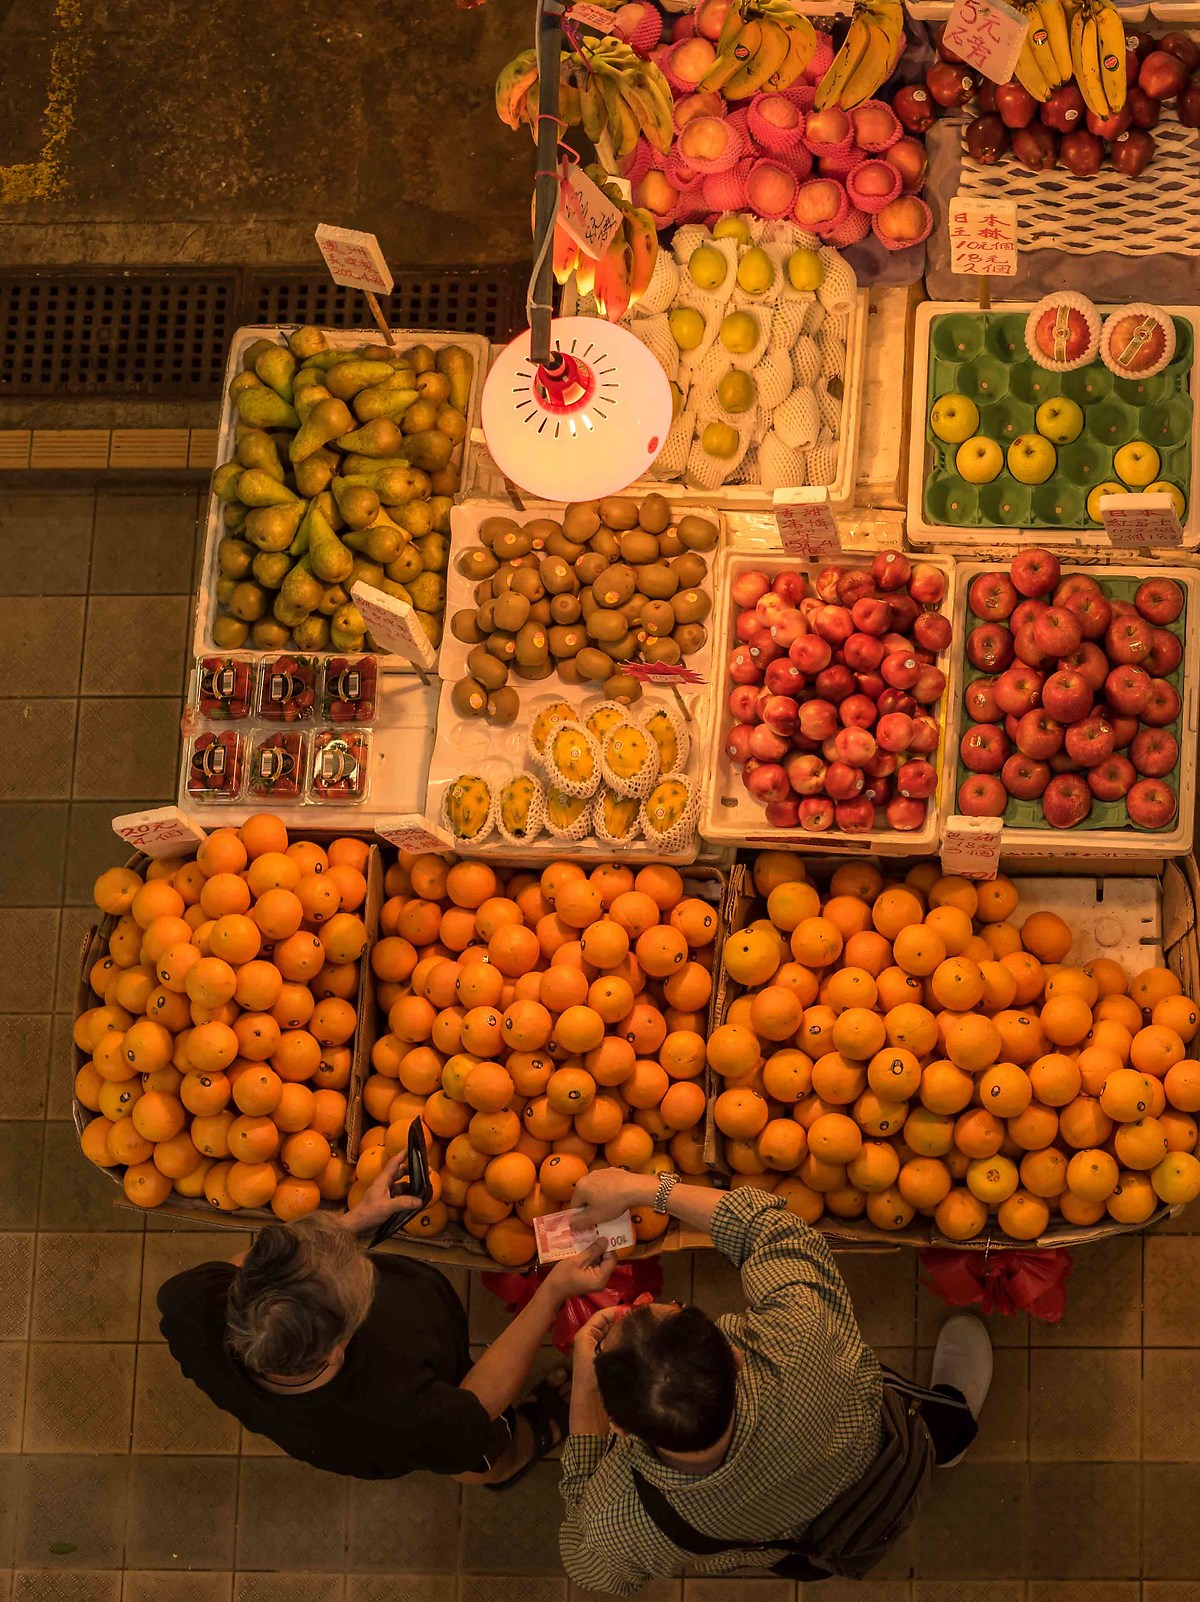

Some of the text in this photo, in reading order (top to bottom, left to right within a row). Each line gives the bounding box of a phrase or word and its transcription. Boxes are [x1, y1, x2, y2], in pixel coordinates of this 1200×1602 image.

[954, 212, 1010, 226] 日本
[956, 253, 1008, 263] 18元
[1109, 509, 1168, 517] 日本
